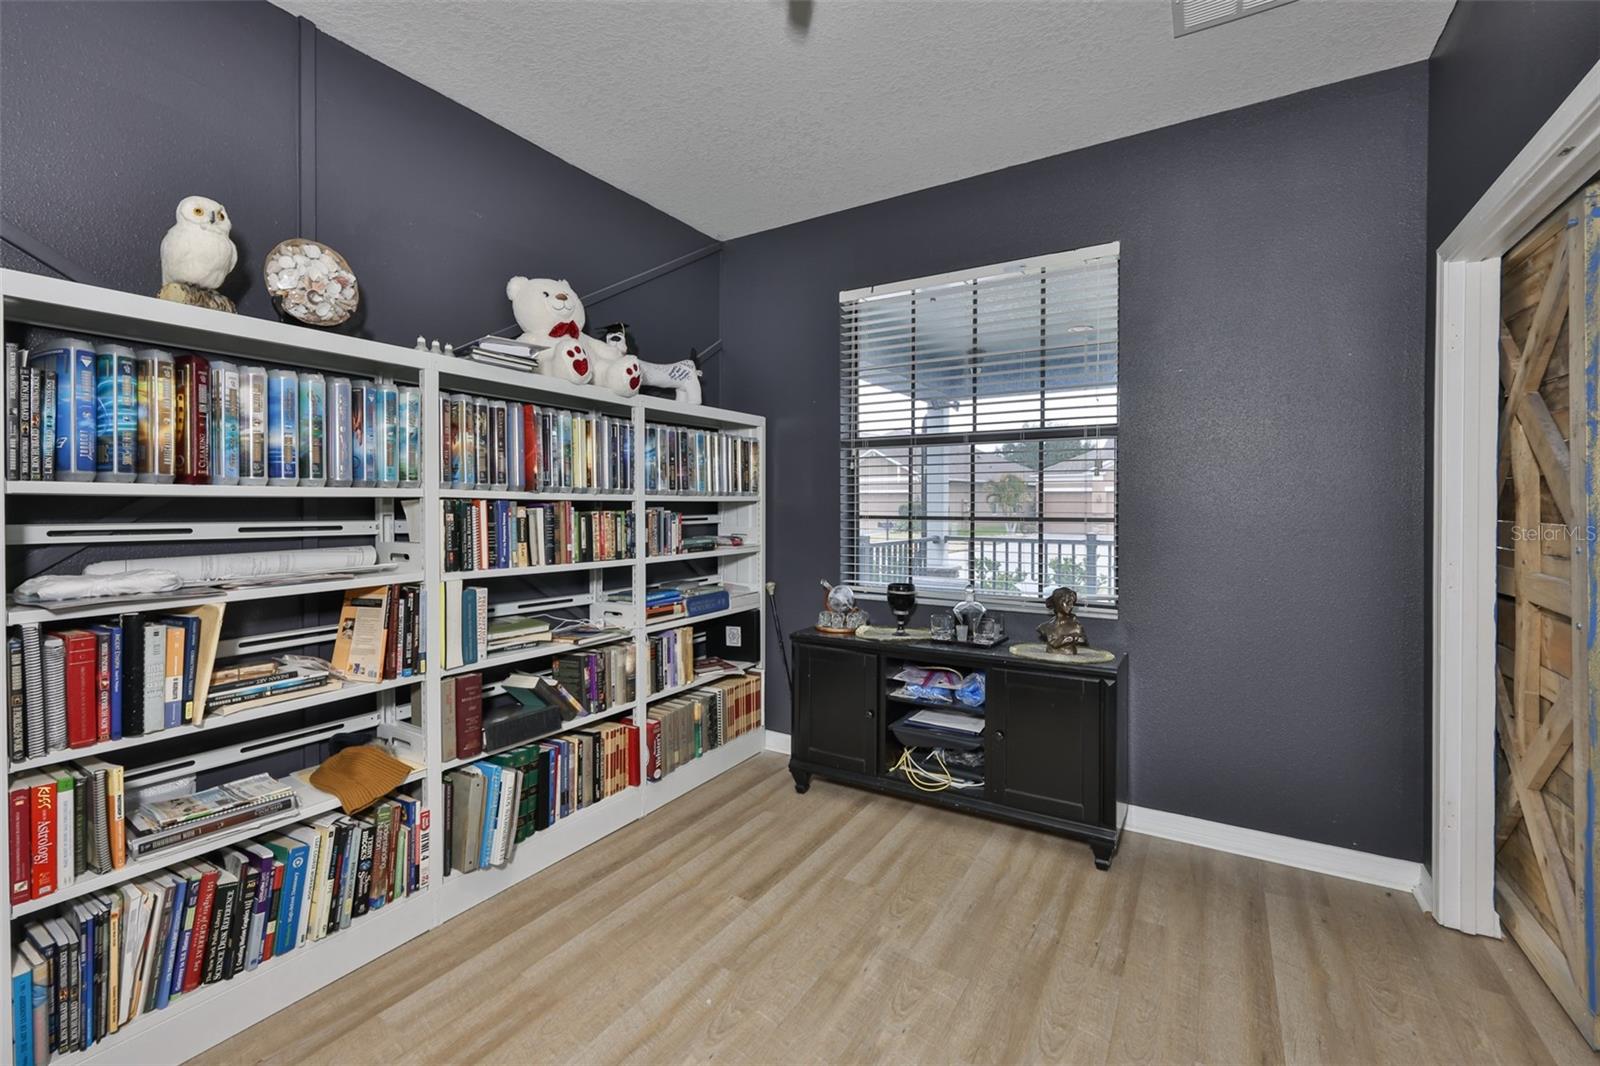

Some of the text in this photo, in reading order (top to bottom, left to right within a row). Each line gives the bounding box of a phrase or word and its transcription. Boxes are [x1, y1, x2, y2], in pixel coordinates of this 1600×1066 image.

[198, 433, 206, 468] CLEARING
[34, 822, 52, 864] Astrology
[360, 830, 368, 860] BROOKS
[421, 832, 430, 854] HTML
[203, 892, 212, 915] Nights
[214, 909, 222, 926] Library
[214, 890, 234, 980] SCIENCE DESK REFERENCE
[236, 909, 250, 966] Creating Motion Graphics
